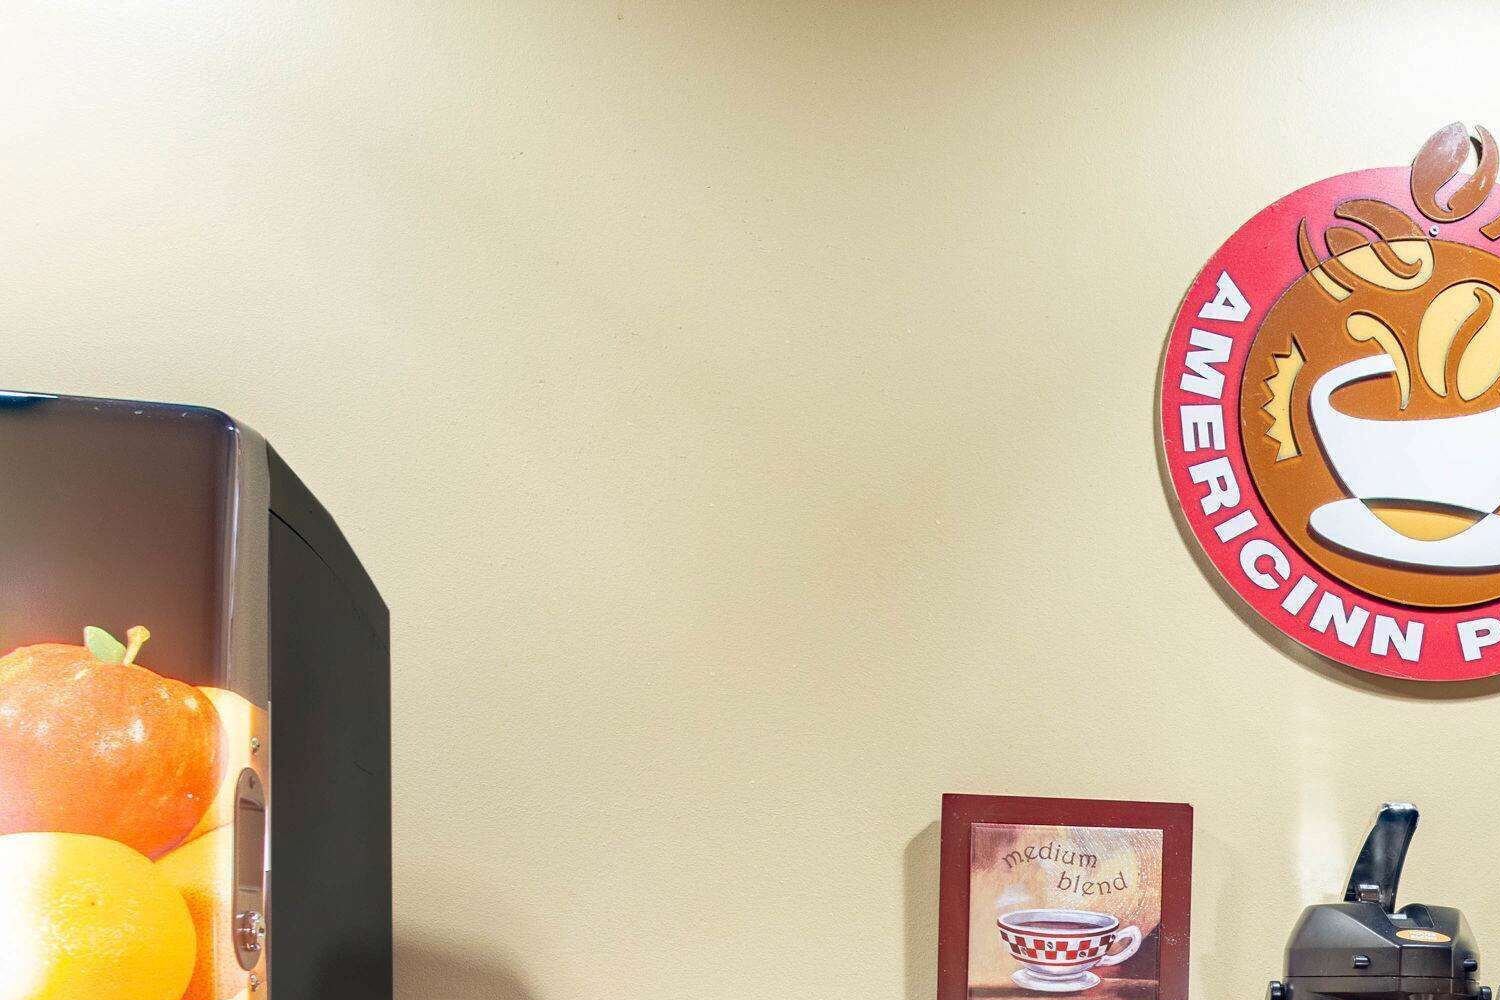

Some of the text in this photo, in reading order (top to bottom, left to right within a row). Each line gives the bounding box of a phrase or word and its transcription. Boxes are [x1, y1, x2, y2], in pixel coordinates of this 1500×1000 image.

[1179, 270, 1424, 663] AMERICINN
[1002, 842, 1098, 869] medium
[1057, 871, 1128, 896] blend
